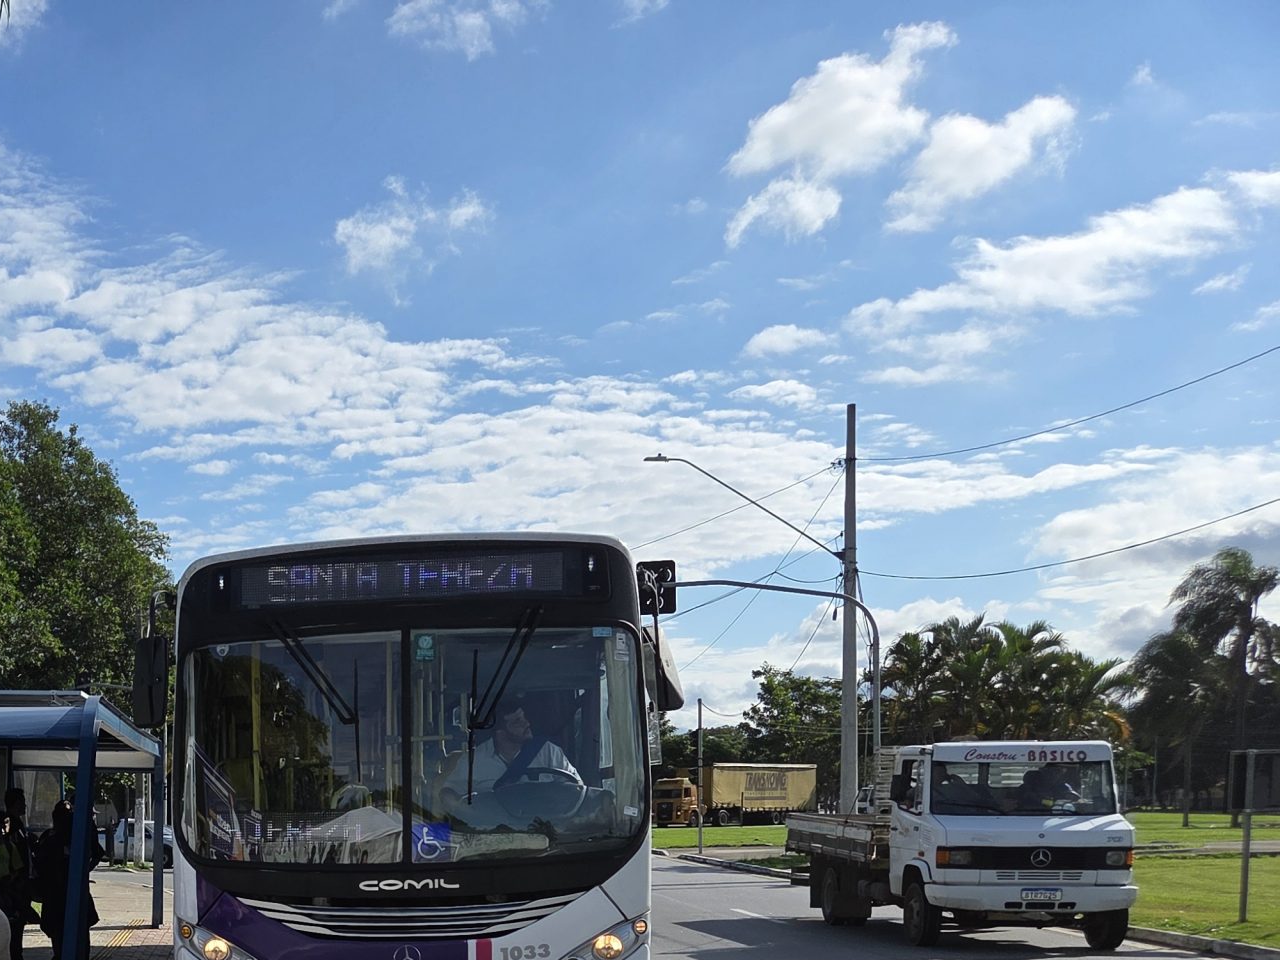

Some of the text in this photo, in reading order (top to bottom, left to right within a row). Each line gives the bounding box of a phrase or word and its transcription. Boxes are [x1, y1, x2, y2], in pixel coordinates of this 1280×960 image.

[964, 748, 1017, 761] Constru
[359, 878, 460, 891] COMIL
[500, 943, 551, 960] 1033
